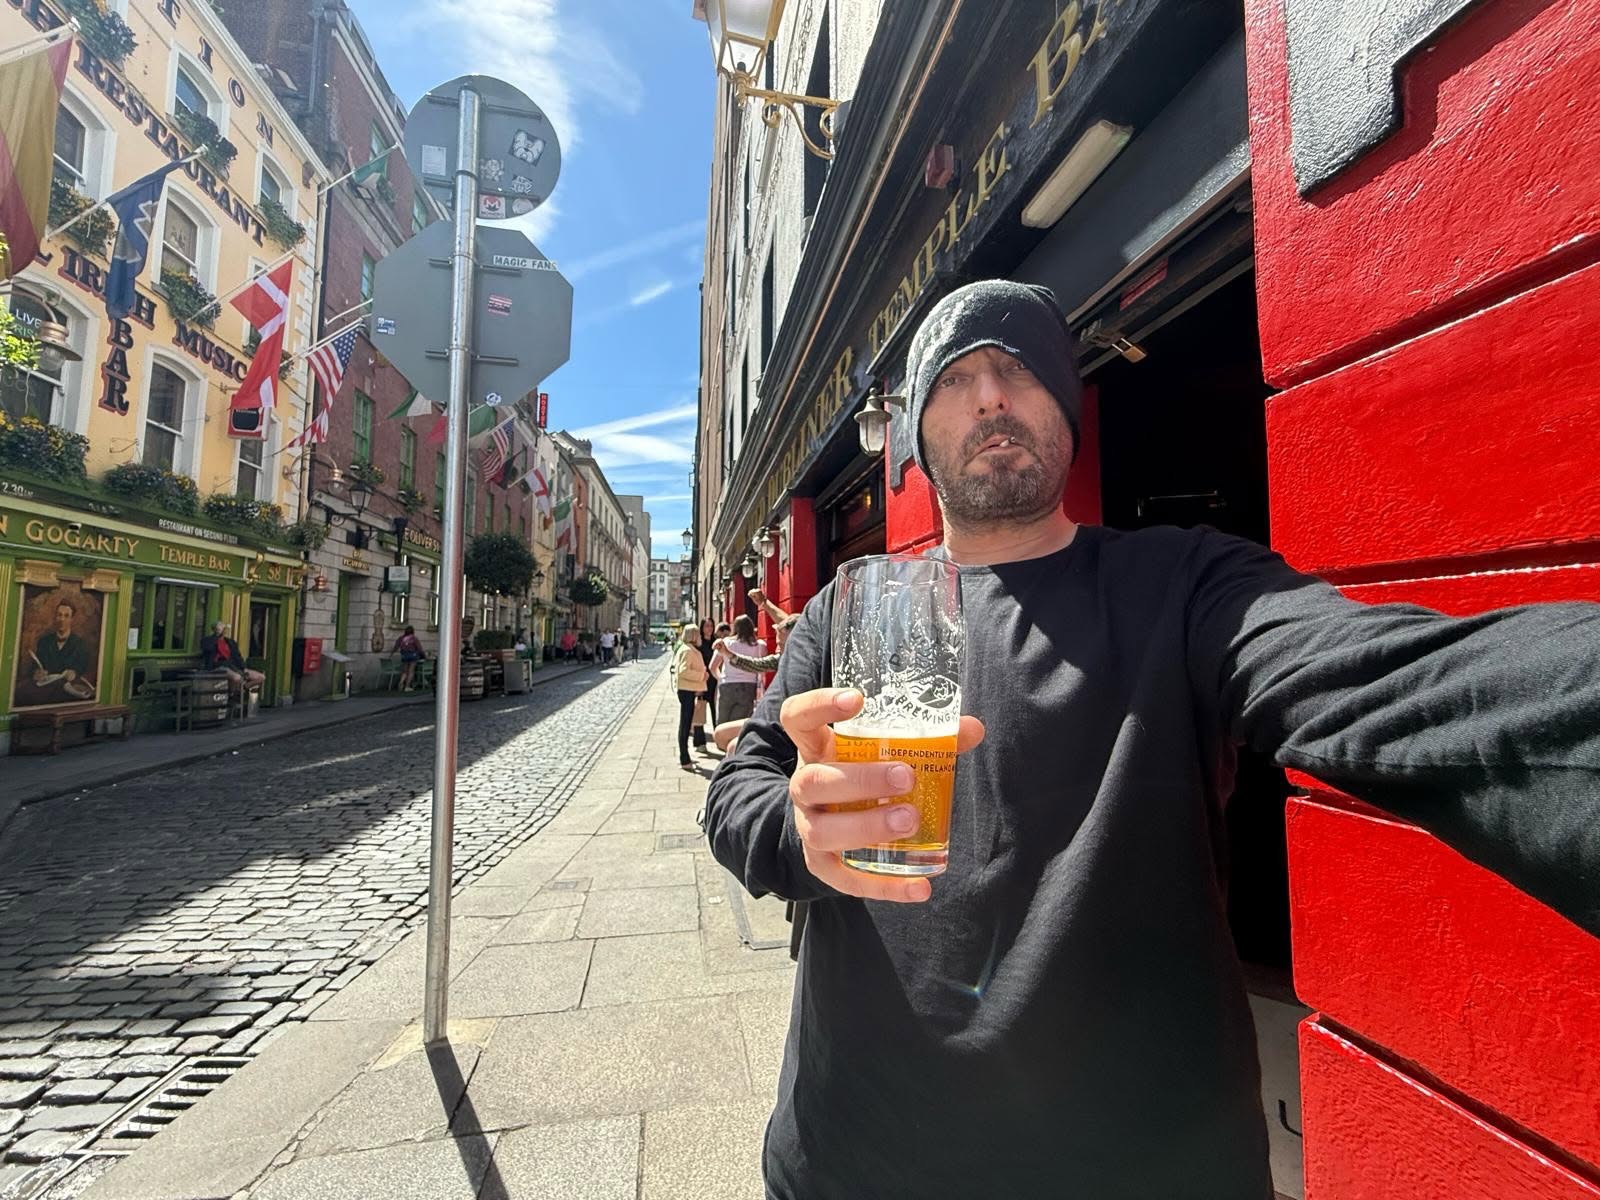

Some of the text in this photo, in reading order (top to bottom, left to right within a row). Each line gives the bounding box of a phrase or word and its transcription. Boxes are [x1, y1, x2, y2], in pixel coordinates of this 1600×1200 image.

[75, 40, 267, 248] RESTAURANT
[865, 119, 1013, 357] TEMPLE
[494, 256, 557, 271] MAGIC FANS
[15, 308, 41, 329] LIVE
[172, 318, 247, 384] MUSIC
[100, 317, 135, 416] BAR
[158, 518, 194, 536] RESTAURANT
[194, 526, 203, 536] ON
[203, 528, 223, 542] SECOND
[25, 519, 140, 557] GOGARTY
[159, 544, 206, 568] TEMPLE
[208, 554, 232, 573] BAR
[895, 694, 951, 724] BREWING
[880, 747, 944, 758] INDEPENDENTLY
[920, 763, 952, 772] IRELAND
